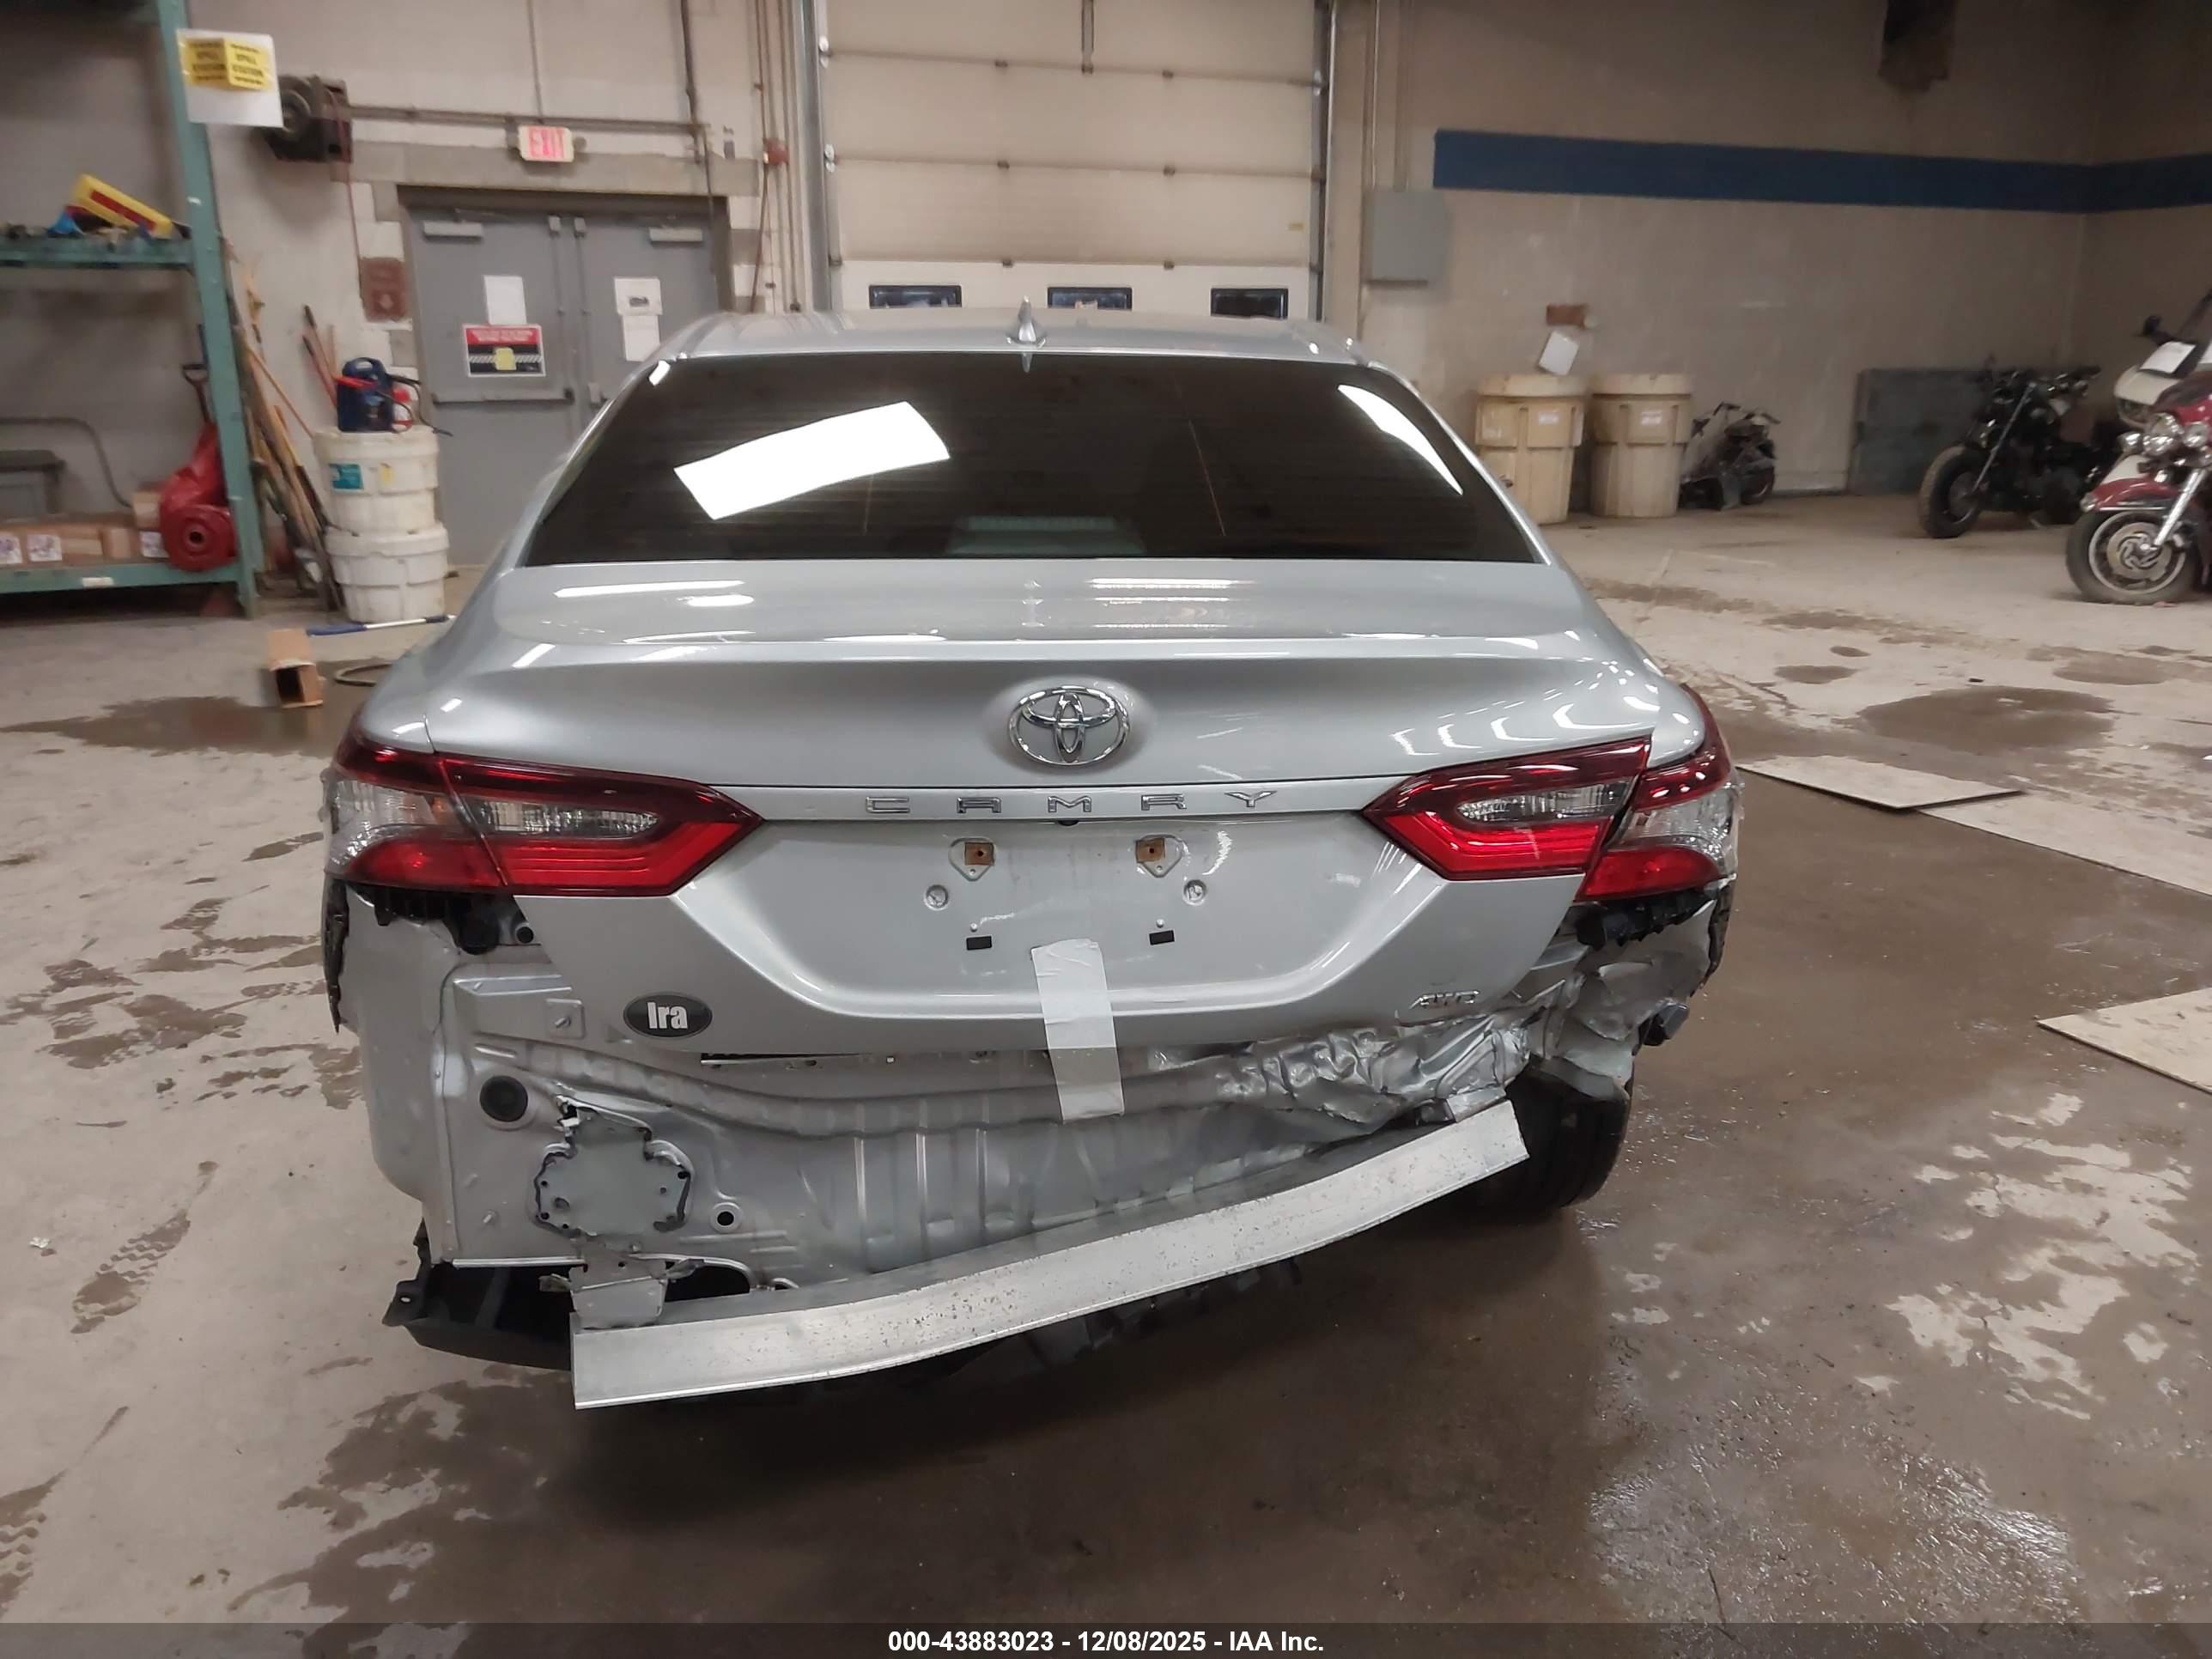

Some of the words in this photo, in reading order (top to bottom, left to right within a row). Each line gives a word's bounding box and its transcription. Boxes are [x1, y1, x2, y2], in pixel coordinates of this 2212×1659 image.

[528, 128, 565, 159] EXIT
[865, 790, 1279, 814] CAMRY
[647, 1001, 689, 1030] Ira
